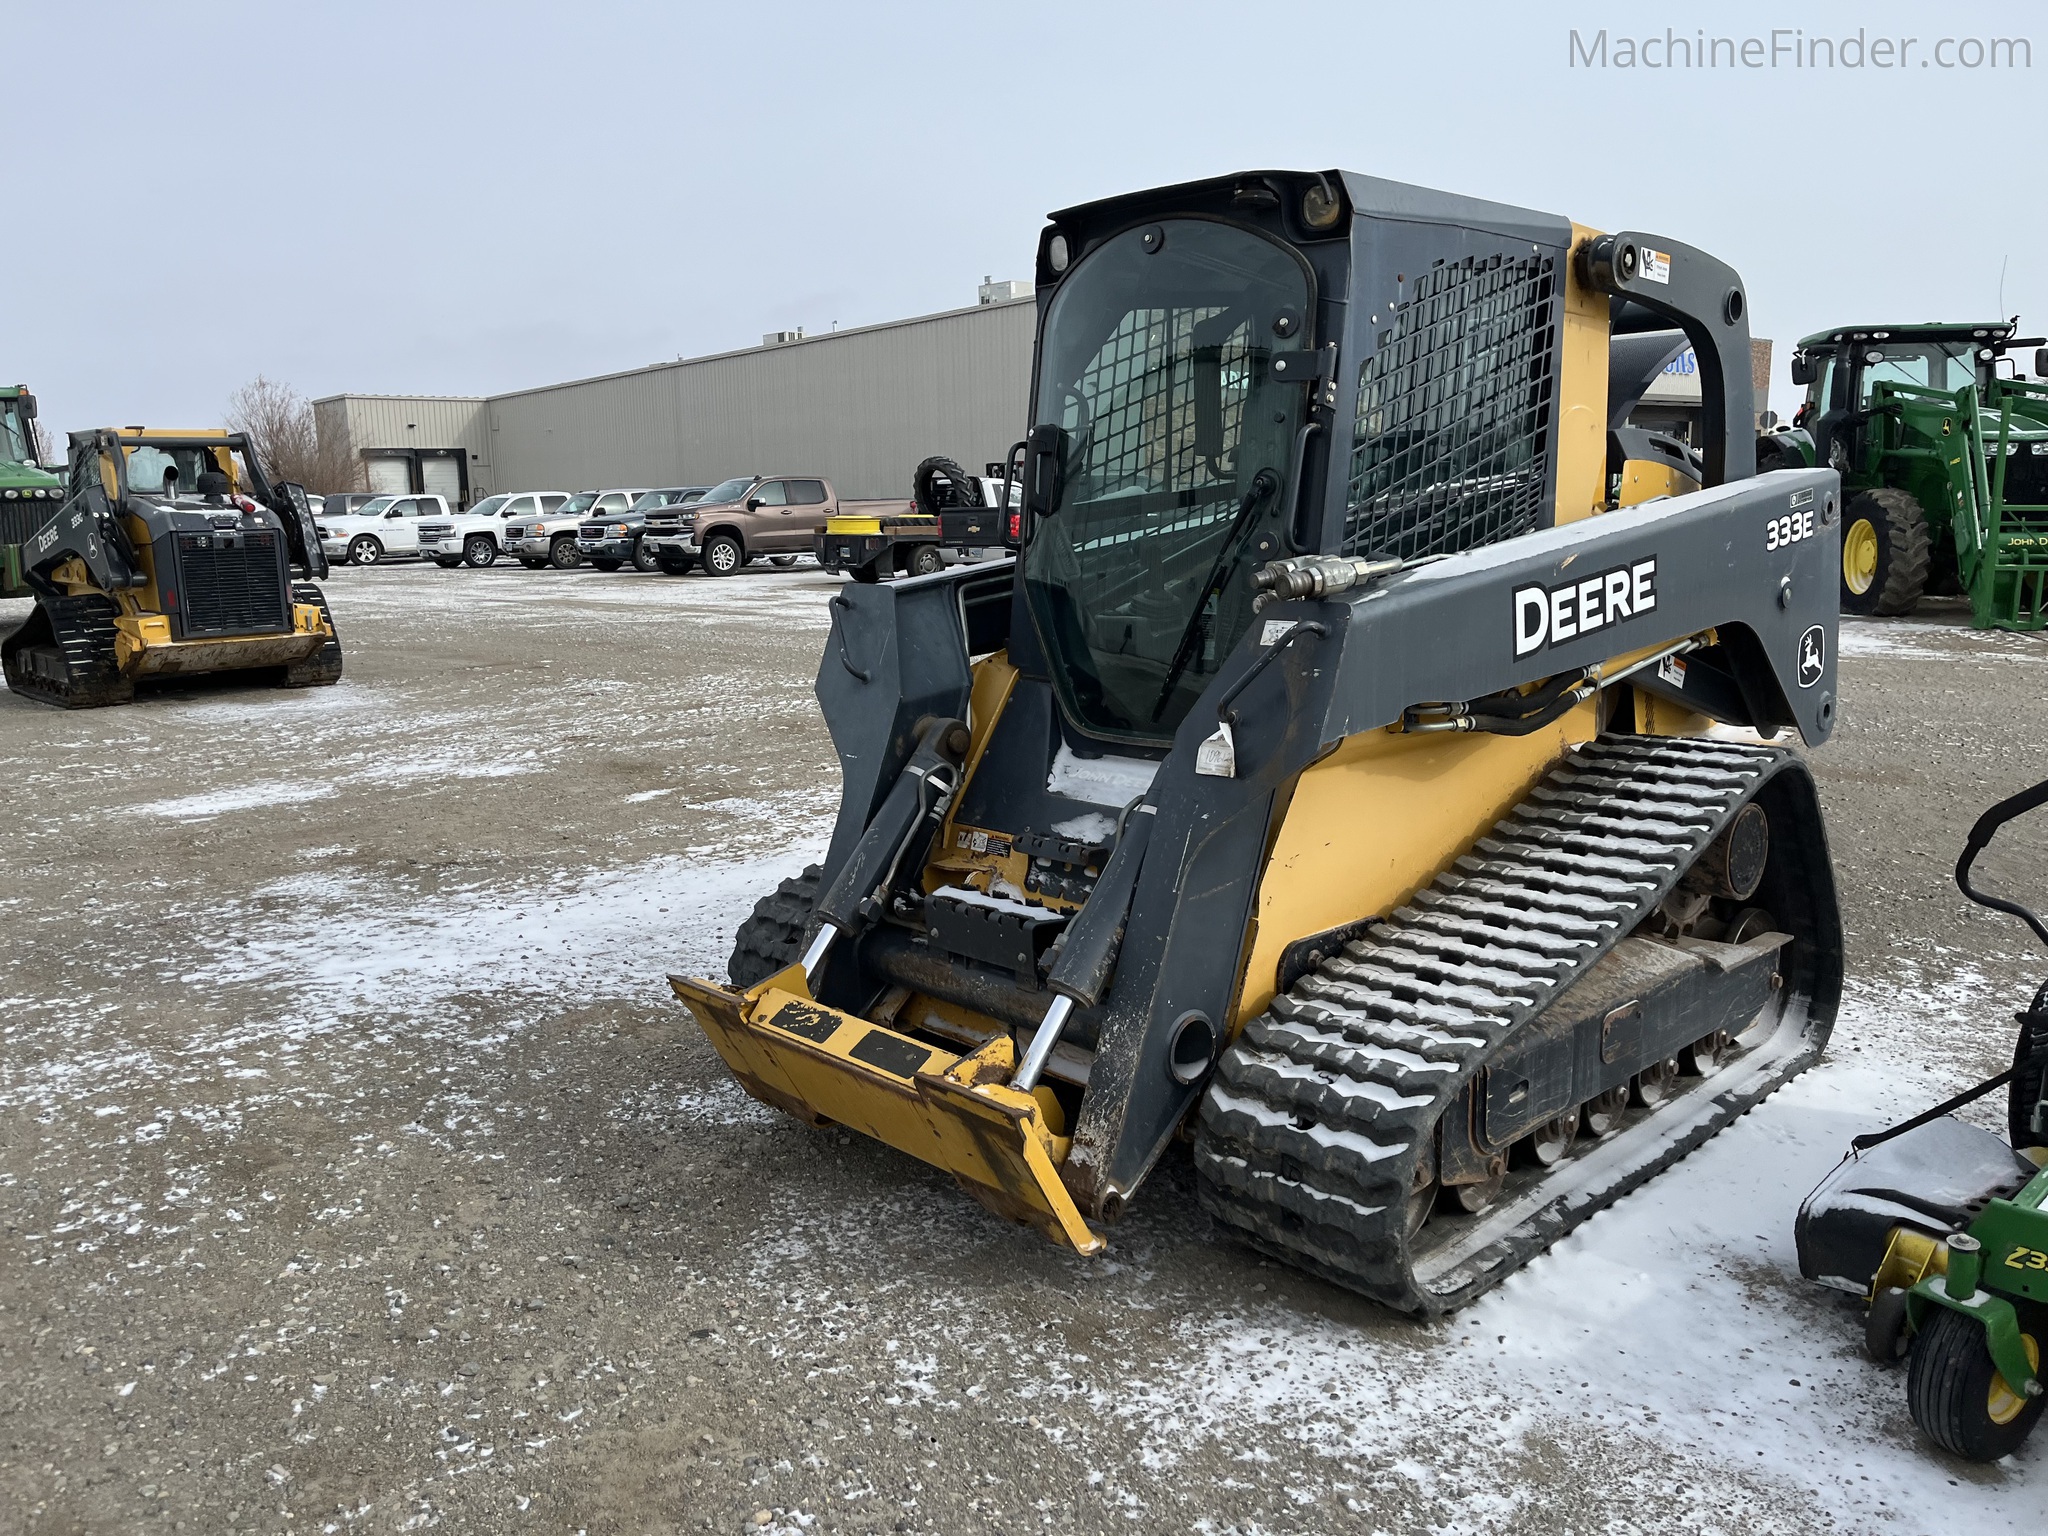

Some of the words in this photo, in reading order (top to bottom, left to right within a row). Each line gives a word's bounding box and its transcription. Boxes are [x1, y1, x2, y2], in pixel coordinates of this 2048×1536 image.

[38, 524, 60, 553] DEERE
[1766, 510, 1814, 551] 333E
[1515, 559, 1656, 656] DEERE
[2005, 1246, 2048, 1271] Z3
